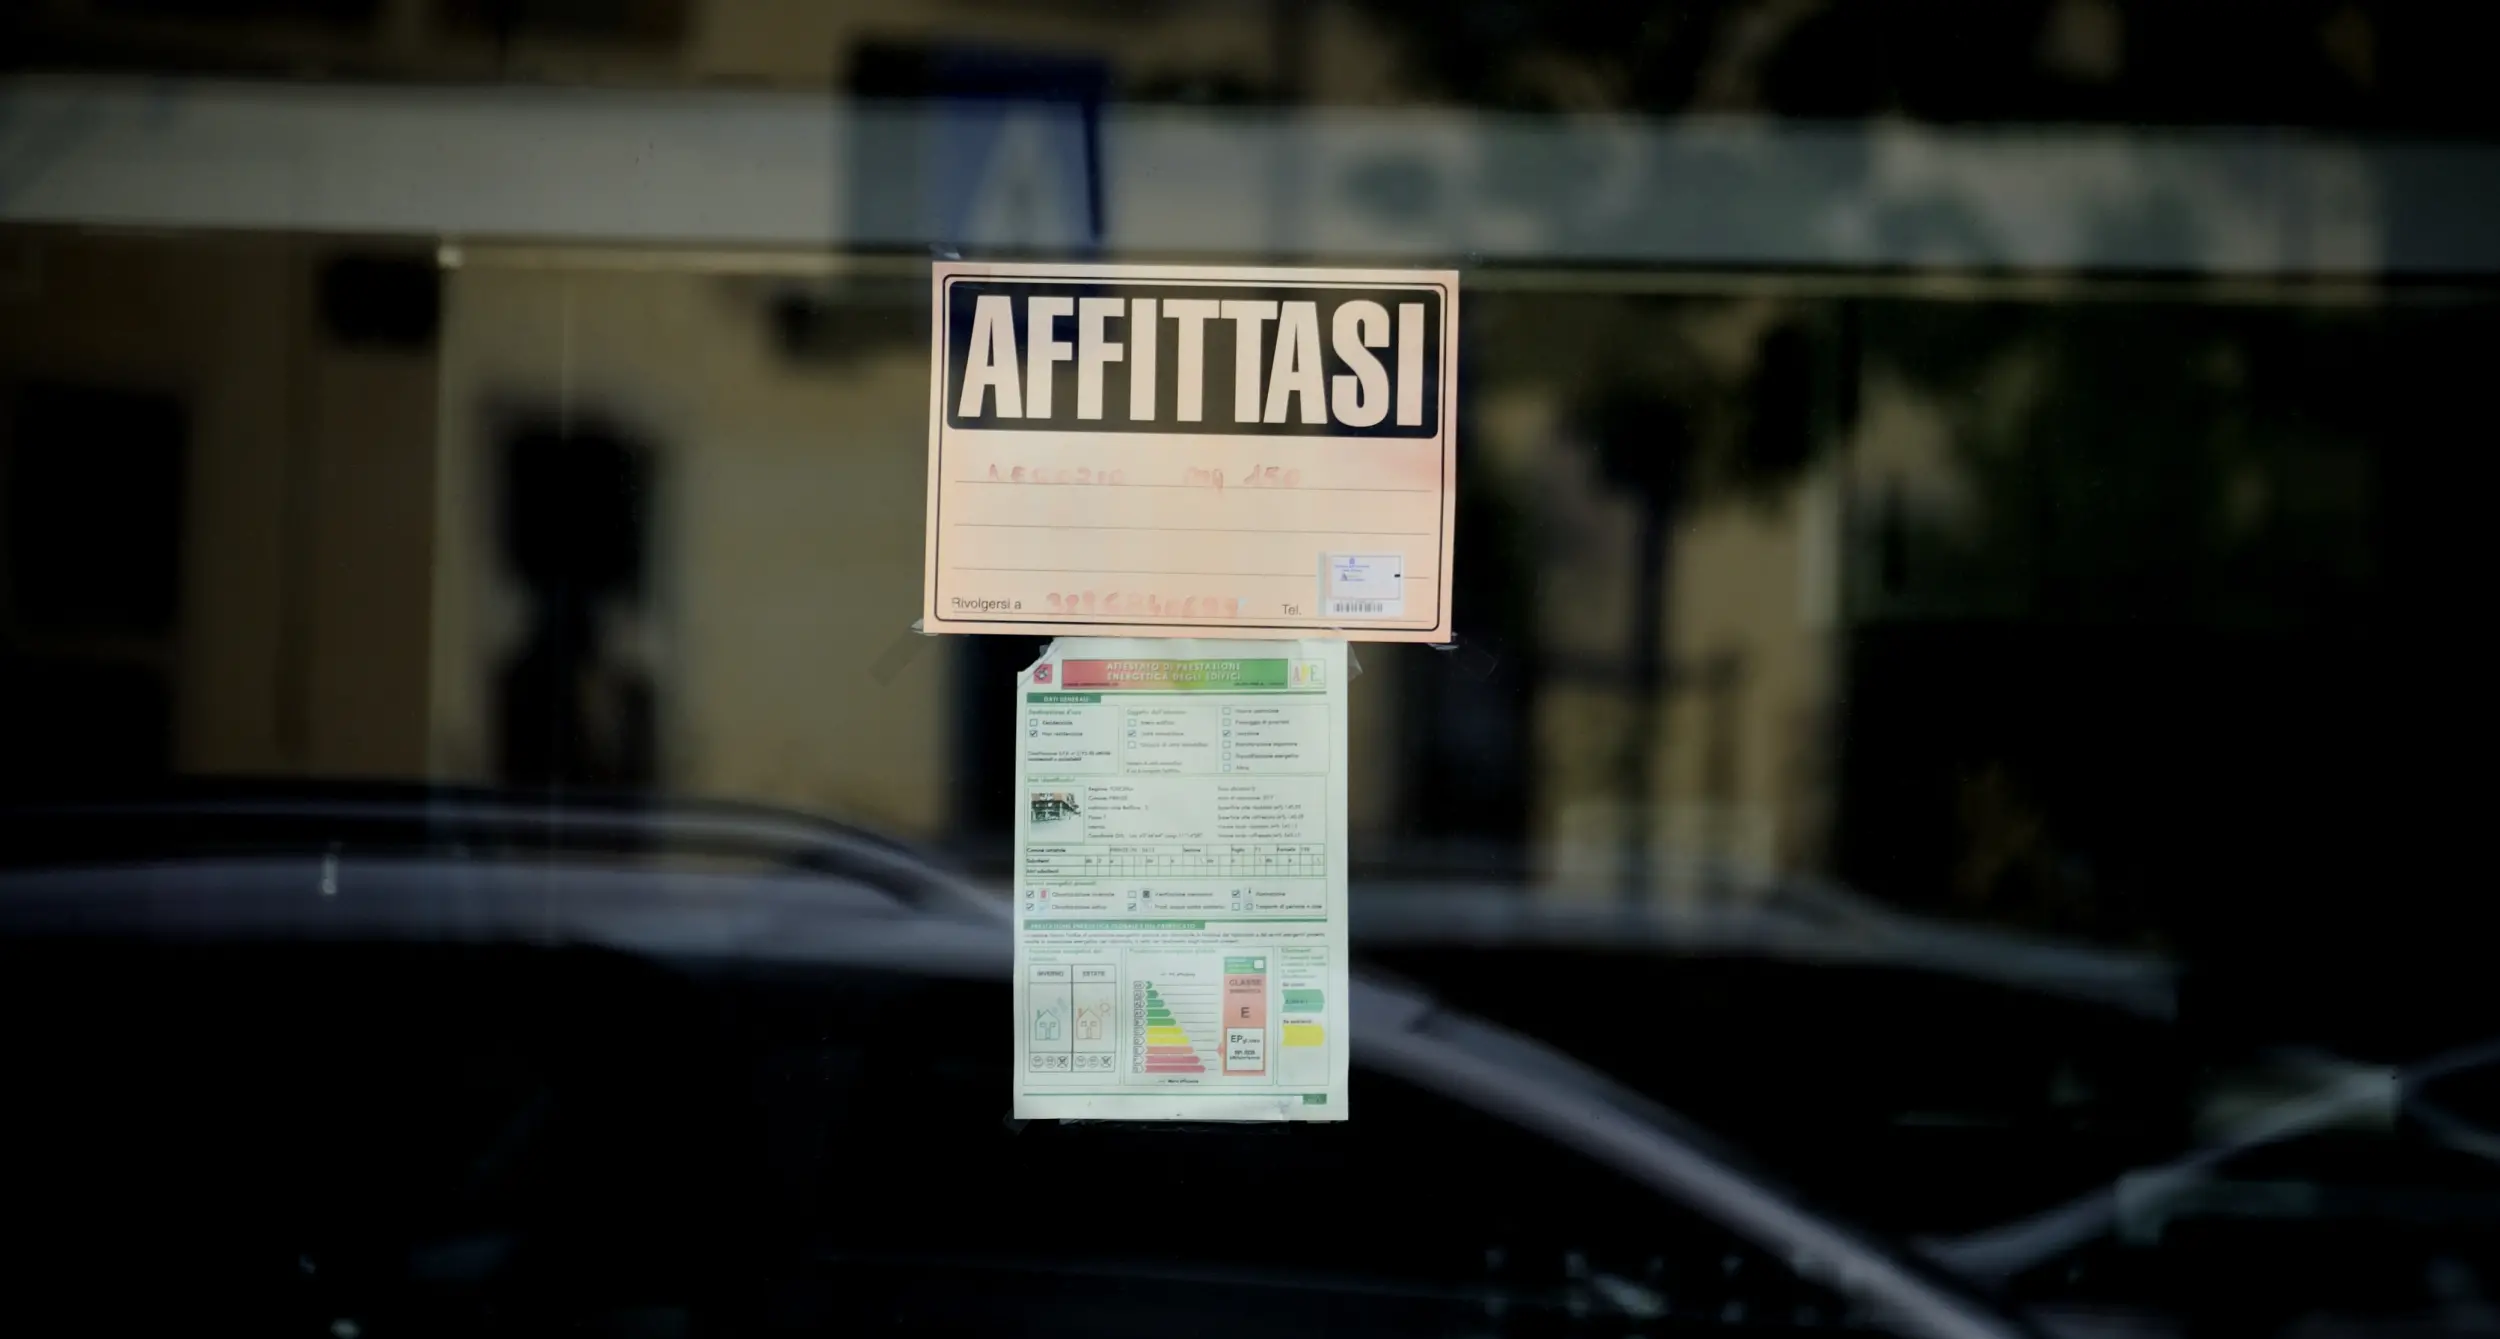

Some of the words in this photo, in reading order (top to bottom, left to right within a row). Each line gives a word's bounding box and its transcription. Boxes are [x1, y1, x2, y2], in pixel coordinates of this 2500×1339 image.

[958, 295, 1425, 427] AFFITTASI
[952, 597, 1011, 612] Rivolgersi
[1014, 602, 1022, 610] a
[1281, 604, 1302, 616] Tel.
[1240, 1006, 1251, 1019] E
